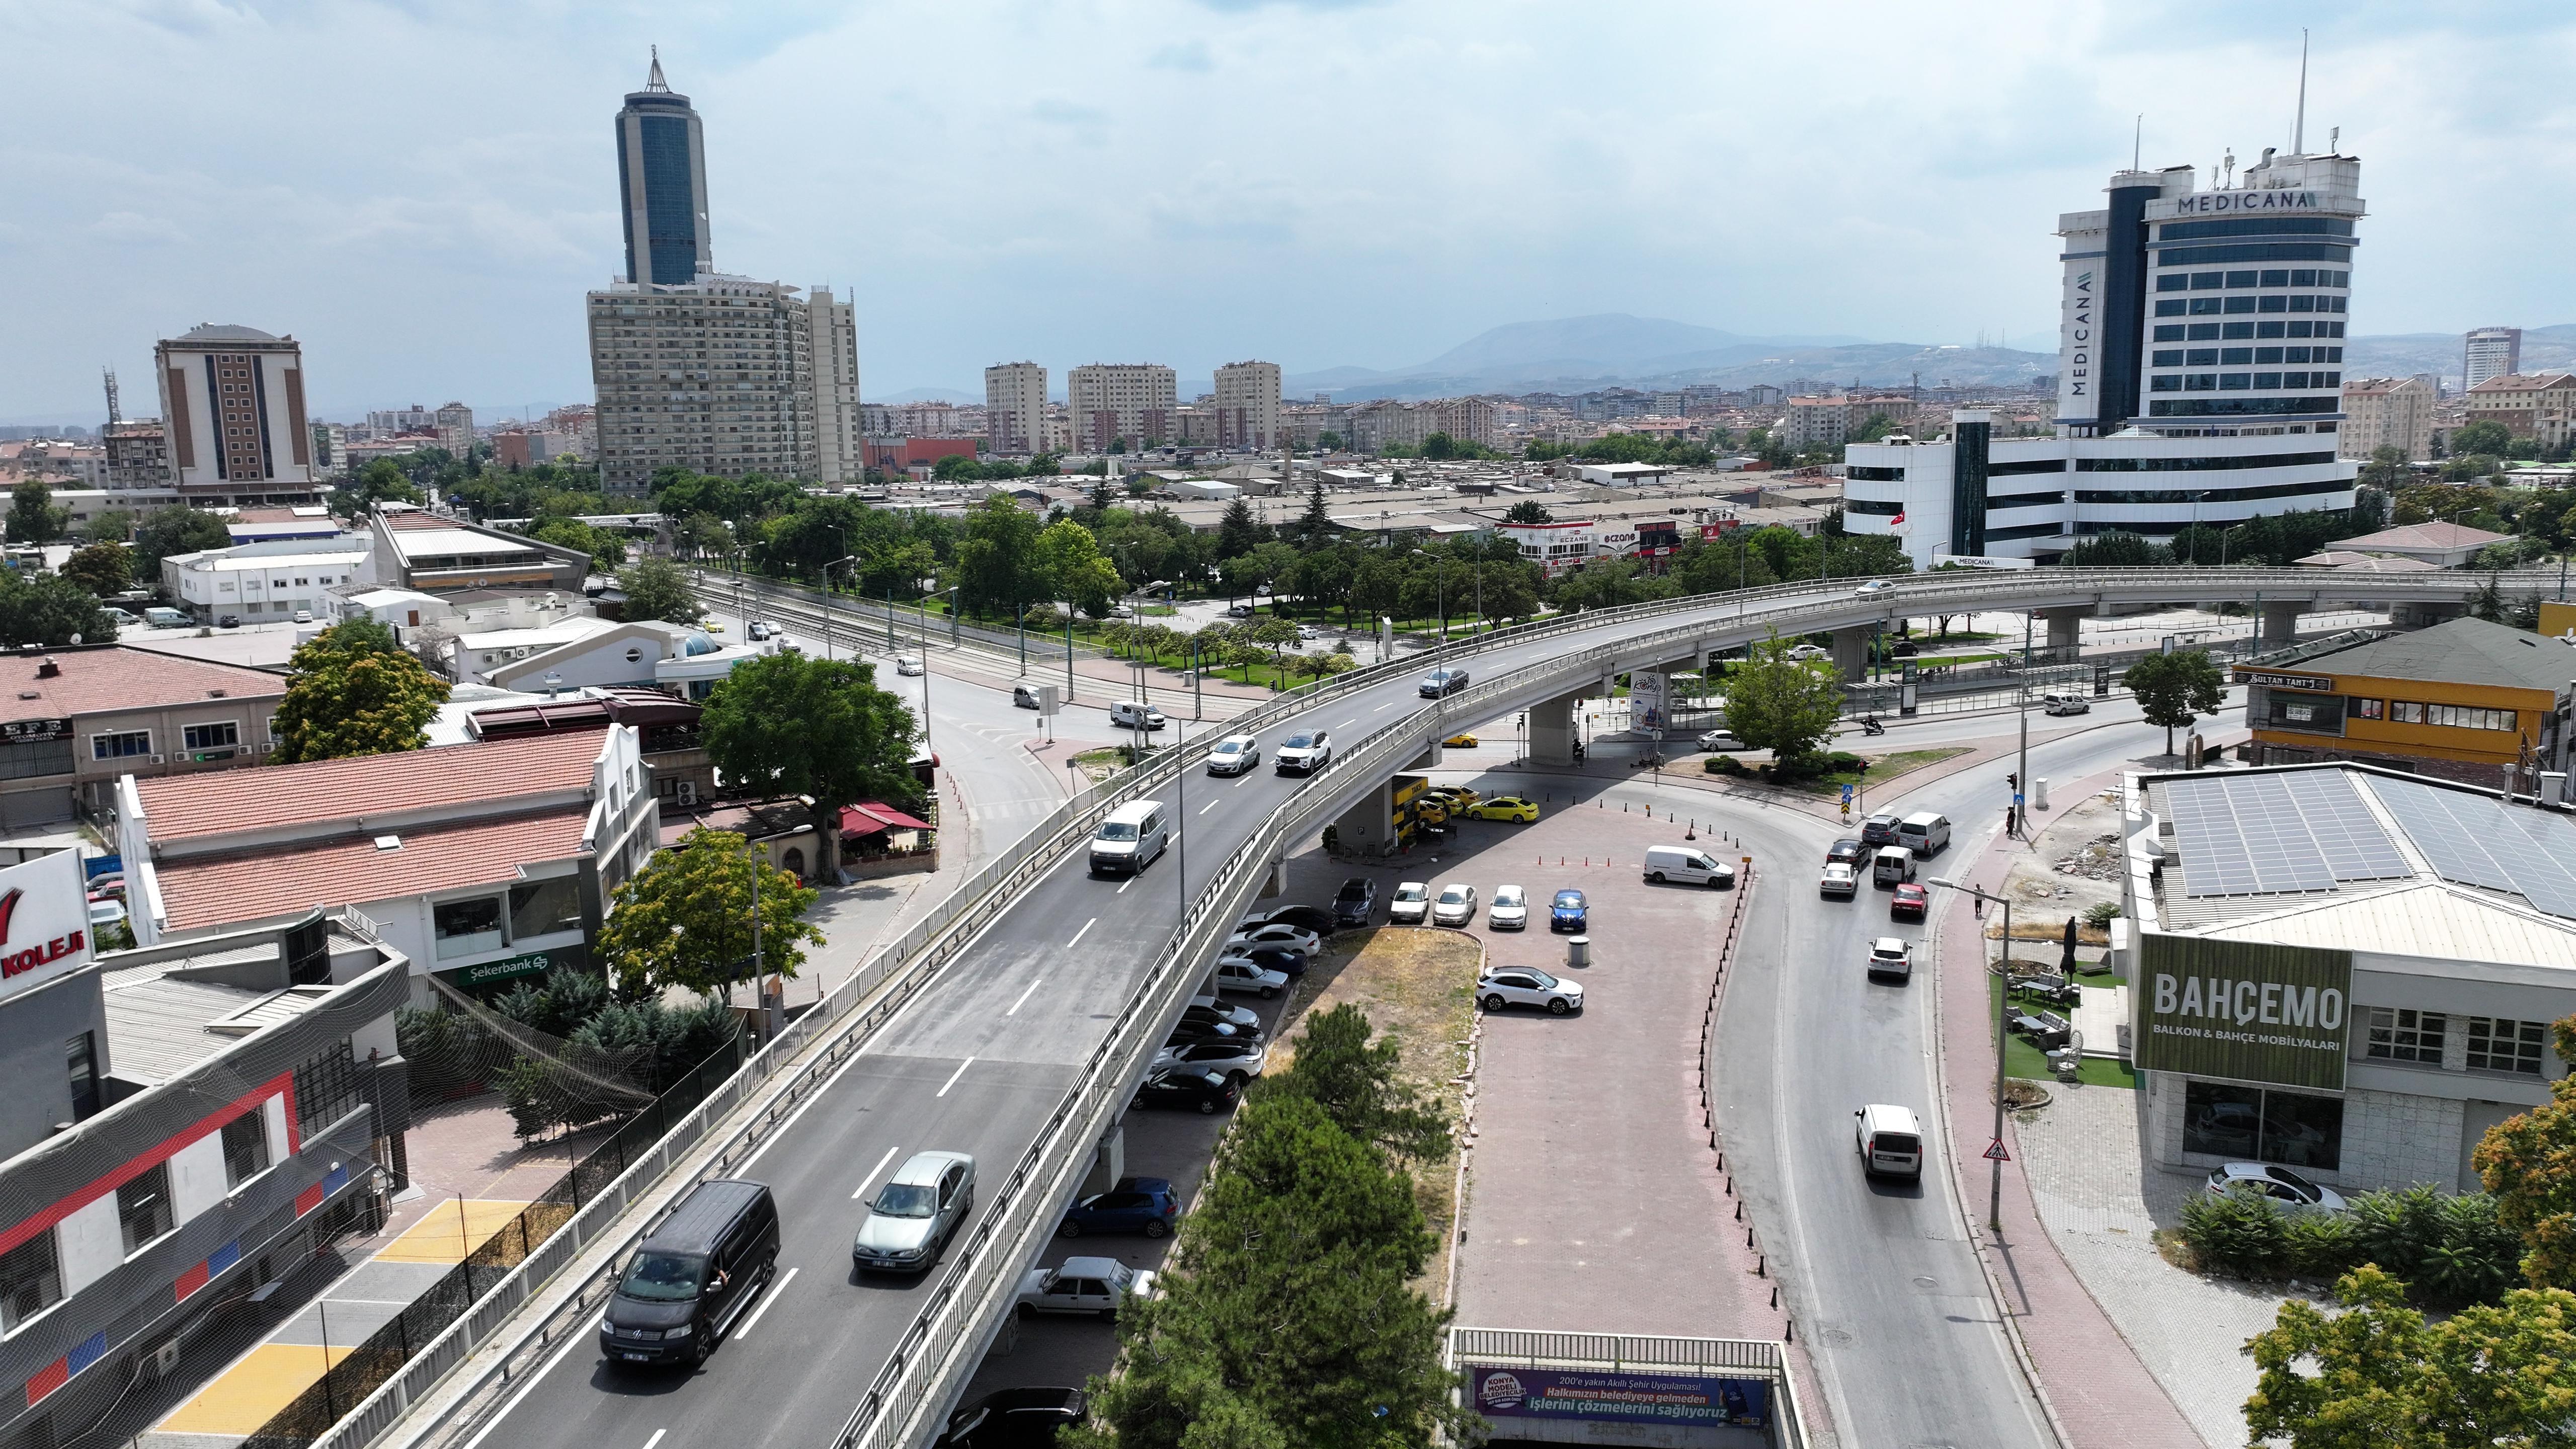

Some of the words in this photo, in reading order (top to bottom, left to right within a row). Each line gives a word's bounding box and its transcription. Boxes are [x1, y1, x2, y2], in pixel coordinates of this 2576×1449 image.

[2178, 192, 2307, 213] MEDICANA
[2072, 281, 2091, 395] MEDICANA
[4, 720, 61, 735] EFE
[470, 958, 531, 982] Şekerbank
[2154, 973, 2343, 1030] BAHÇEMO
[2153, 1024, 2201, 1037] BALKON
[2203, 1029, 2213, 1038] &
[2216, 1030, 2255, 1044] BAHÇE
[2259, 1034, 2340, 1051] MOBİLYALARI
[1488, 1377, 1514, 1386] KONYA
[1488, 1384, 1517, 1392] MODELİ
[1560, 1377, 1582, 1385] 200'e
[1584, 1378, 1605, 1388] yakın
[1607, 1379, 1627, 1388] Akıllı
[1628, 1380, 1649, 1390] Şehir
[1651, 1381, 1701, 1391] Uygulaması!
[1547, 1388, 1598, 1399] Halkımızın
[1600, 1390, 1654, 1402] belediyeye
[1656, 1393, 1706, 1404] gelmeden
[1530, 1397, 1576, 1411] işlerini
[1577, 1399, 1655, 1413] çözmelerini
[1657, 1403, 1728, 1419] sağlıyoruz
